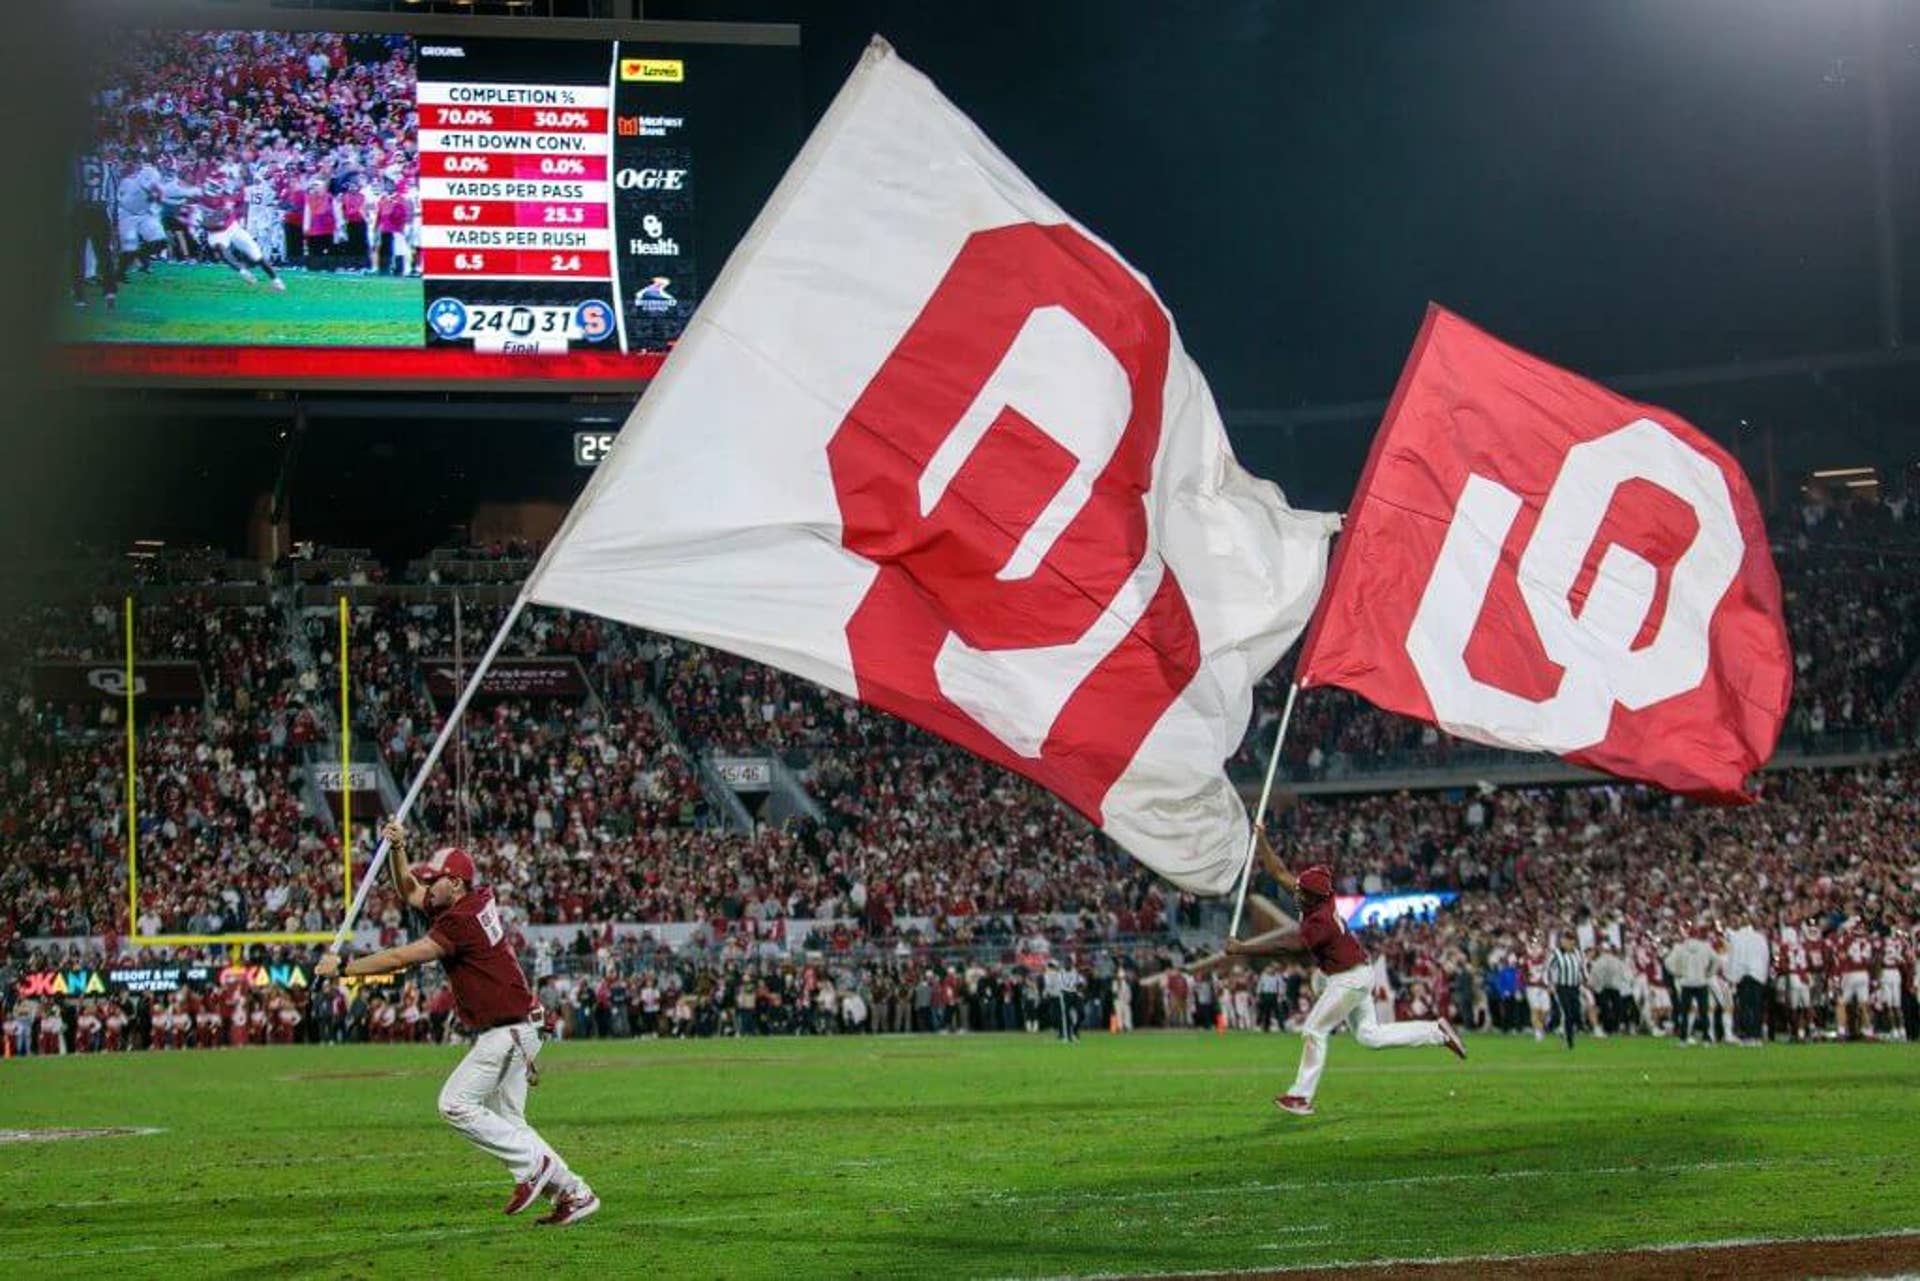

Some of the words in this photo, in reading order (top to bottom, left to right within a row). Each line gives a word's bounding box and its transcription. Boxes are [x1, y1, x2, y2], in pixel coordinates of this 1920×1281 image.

[449, 87, 556, 103] COMPLETION
[562, 90, 575, 104] %
[436, 109, 493, 125] 70.0%
[440, 135, 473, 148] 4TH
[478, 137, 532, 149] DOWN
[536, 138, 586, 151] CONV.
[444, 157, 489, 173] 0.0%
[541, 158, 585, 175] 0.0%
[447, 183, 501, 197] YARDS
[506, 184, 537, 198] PER
[543, 185, 584, 198] PASS
[452, 206, 481, 221] 6.7
[543, 207, 584, 222] 25.3
[446, 230, 501, 244] YARDS
[506, 231, 537, 245] PER
[542, 232, 586, 246] RUSH
[630, 238, 679, 256] Health
[454, 254, 484, 269] 6.5
[470, 310, 504, 332] 24
[542, 310, 571, 332] 31
[503, 341, 540, 355] Final
